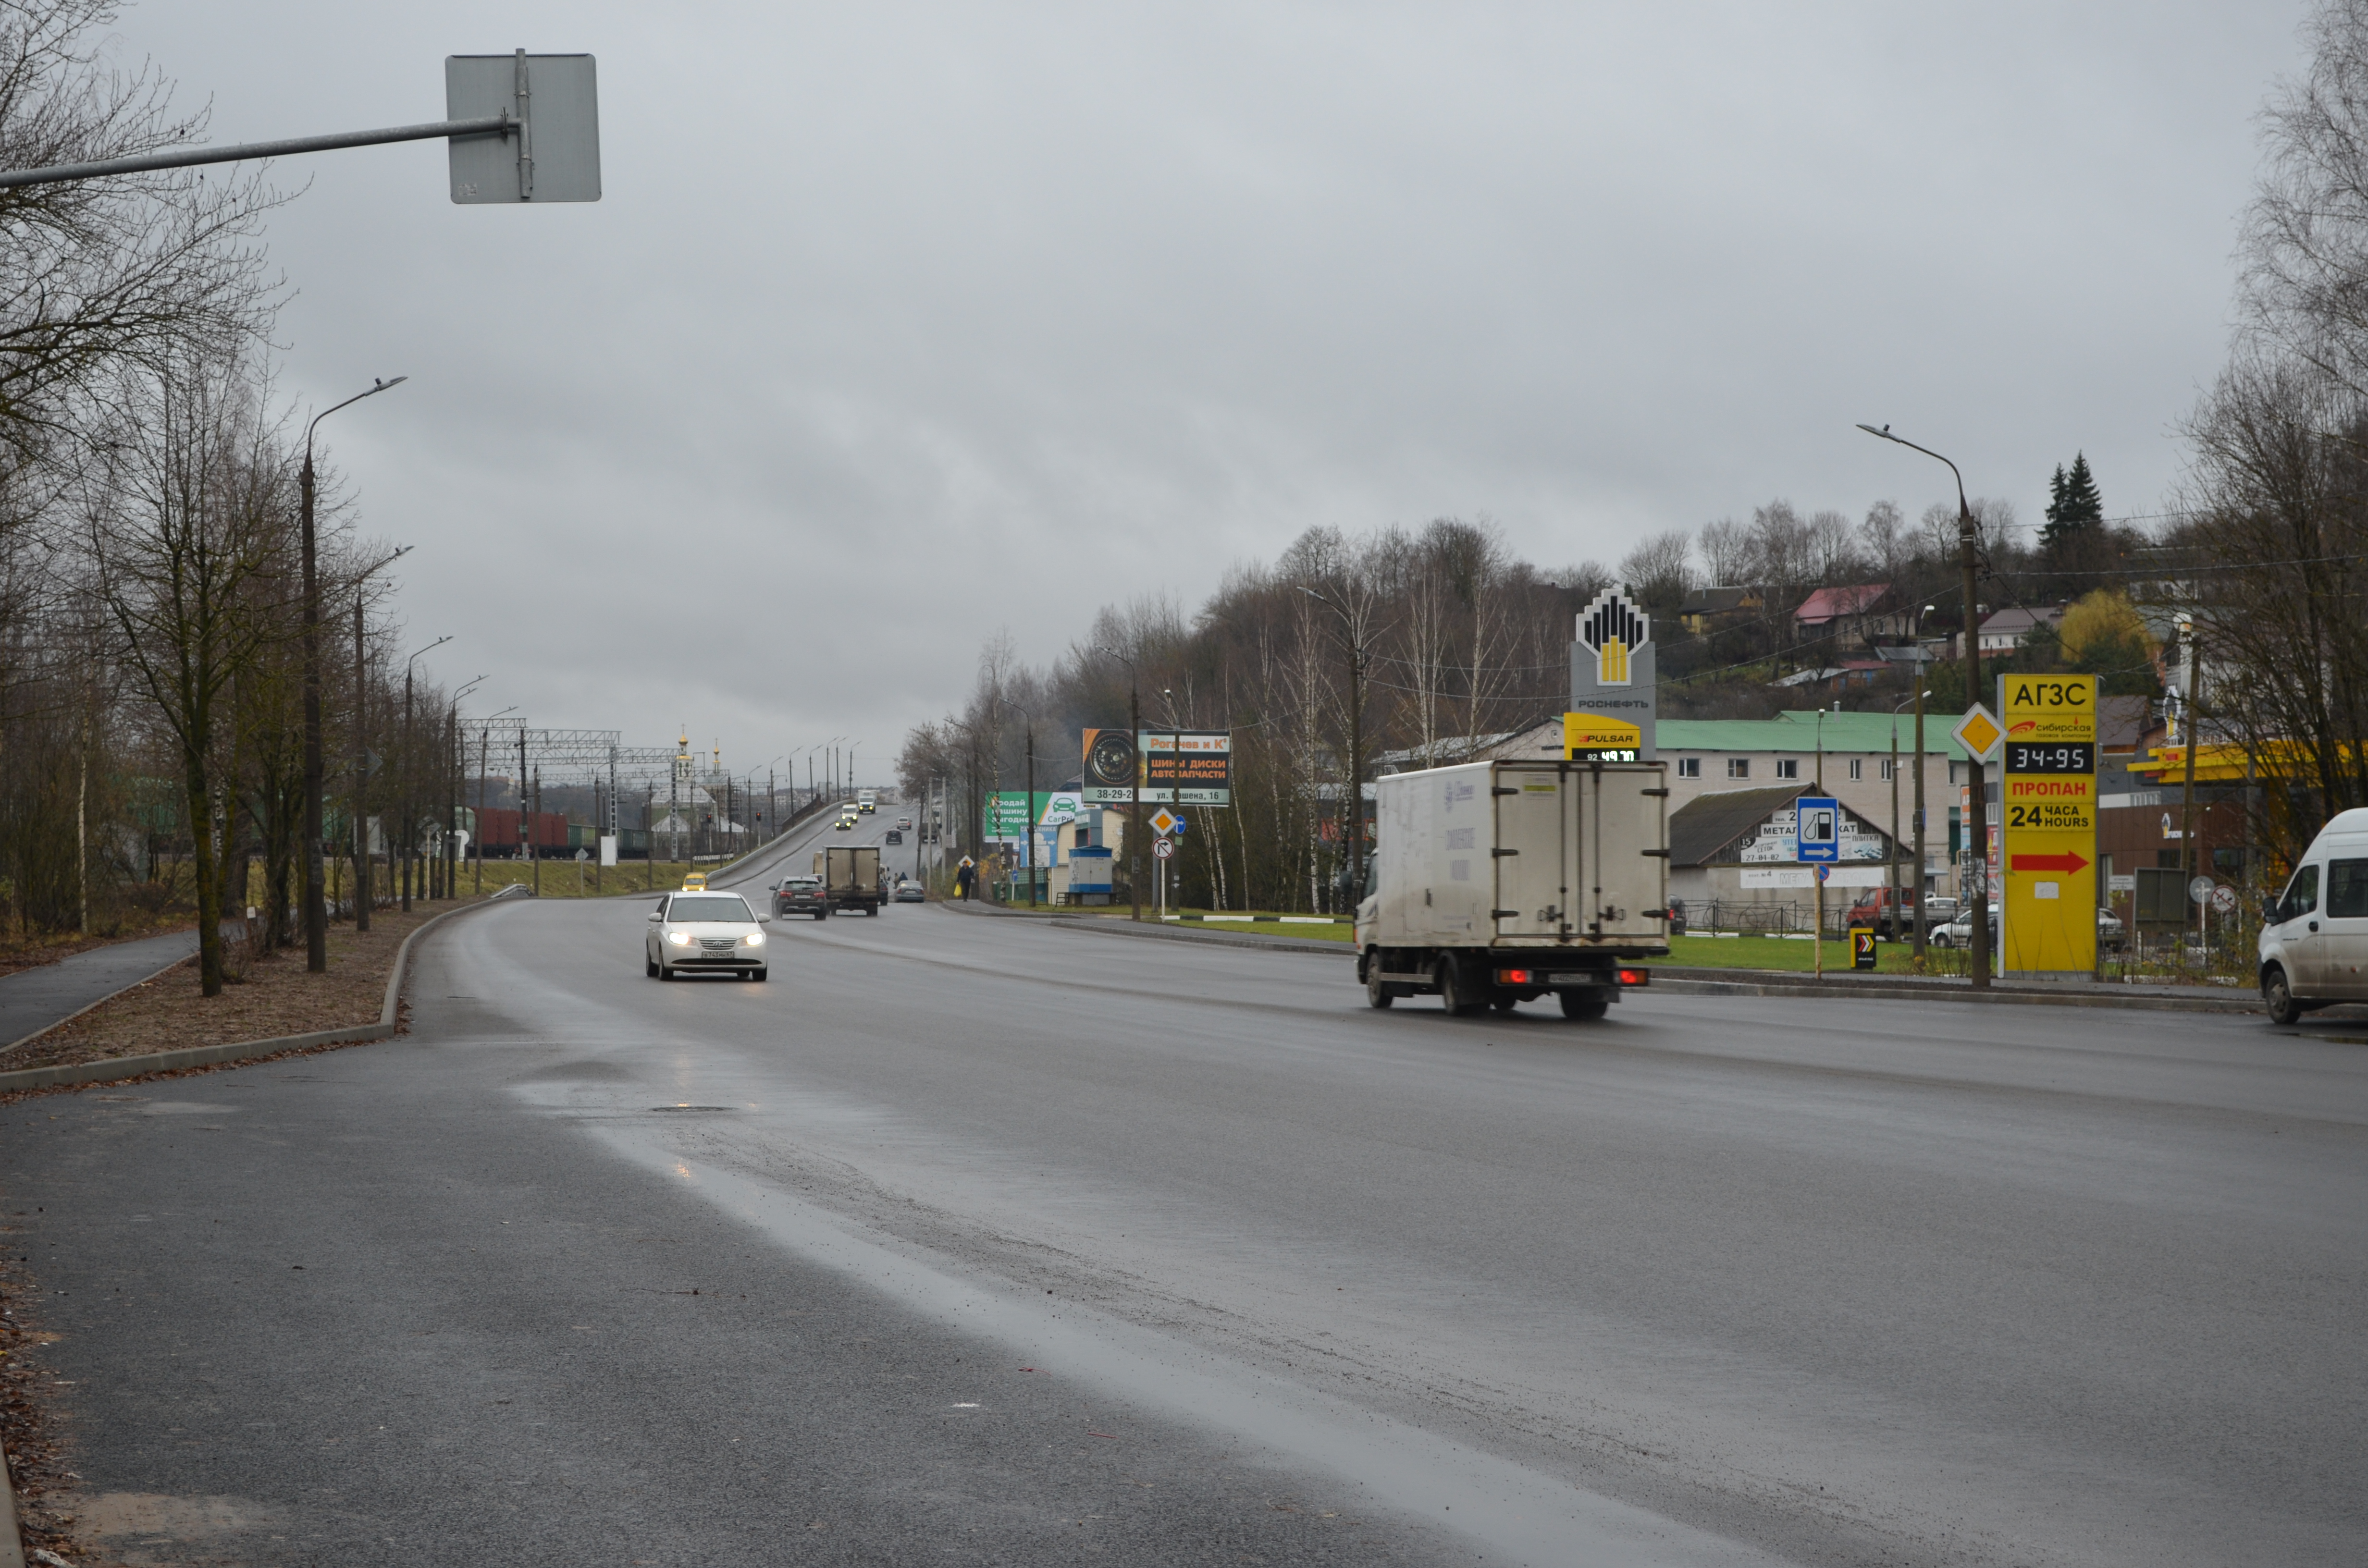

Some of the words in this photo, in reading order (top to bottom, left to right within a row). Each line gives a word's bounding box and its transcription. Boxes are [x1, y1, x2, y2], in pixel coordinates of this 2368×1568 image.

[2014, 683, 2086, 705] АГЗС
[2036, 723, 2091, 732] сибирская
[2016, 749, 2084, 768] 34-95
[1190, 760, 1226, 769] ДИСКИ
[1097, 789, 1132, 798] 38-29-2
[2012, 782, 2086, 796] ПРОПАН
[2045, 806, 2079, 815] ЧАСА
[2010, 806, 2042, 827] 24
[2045, 818, 2089, 827] HOURS
